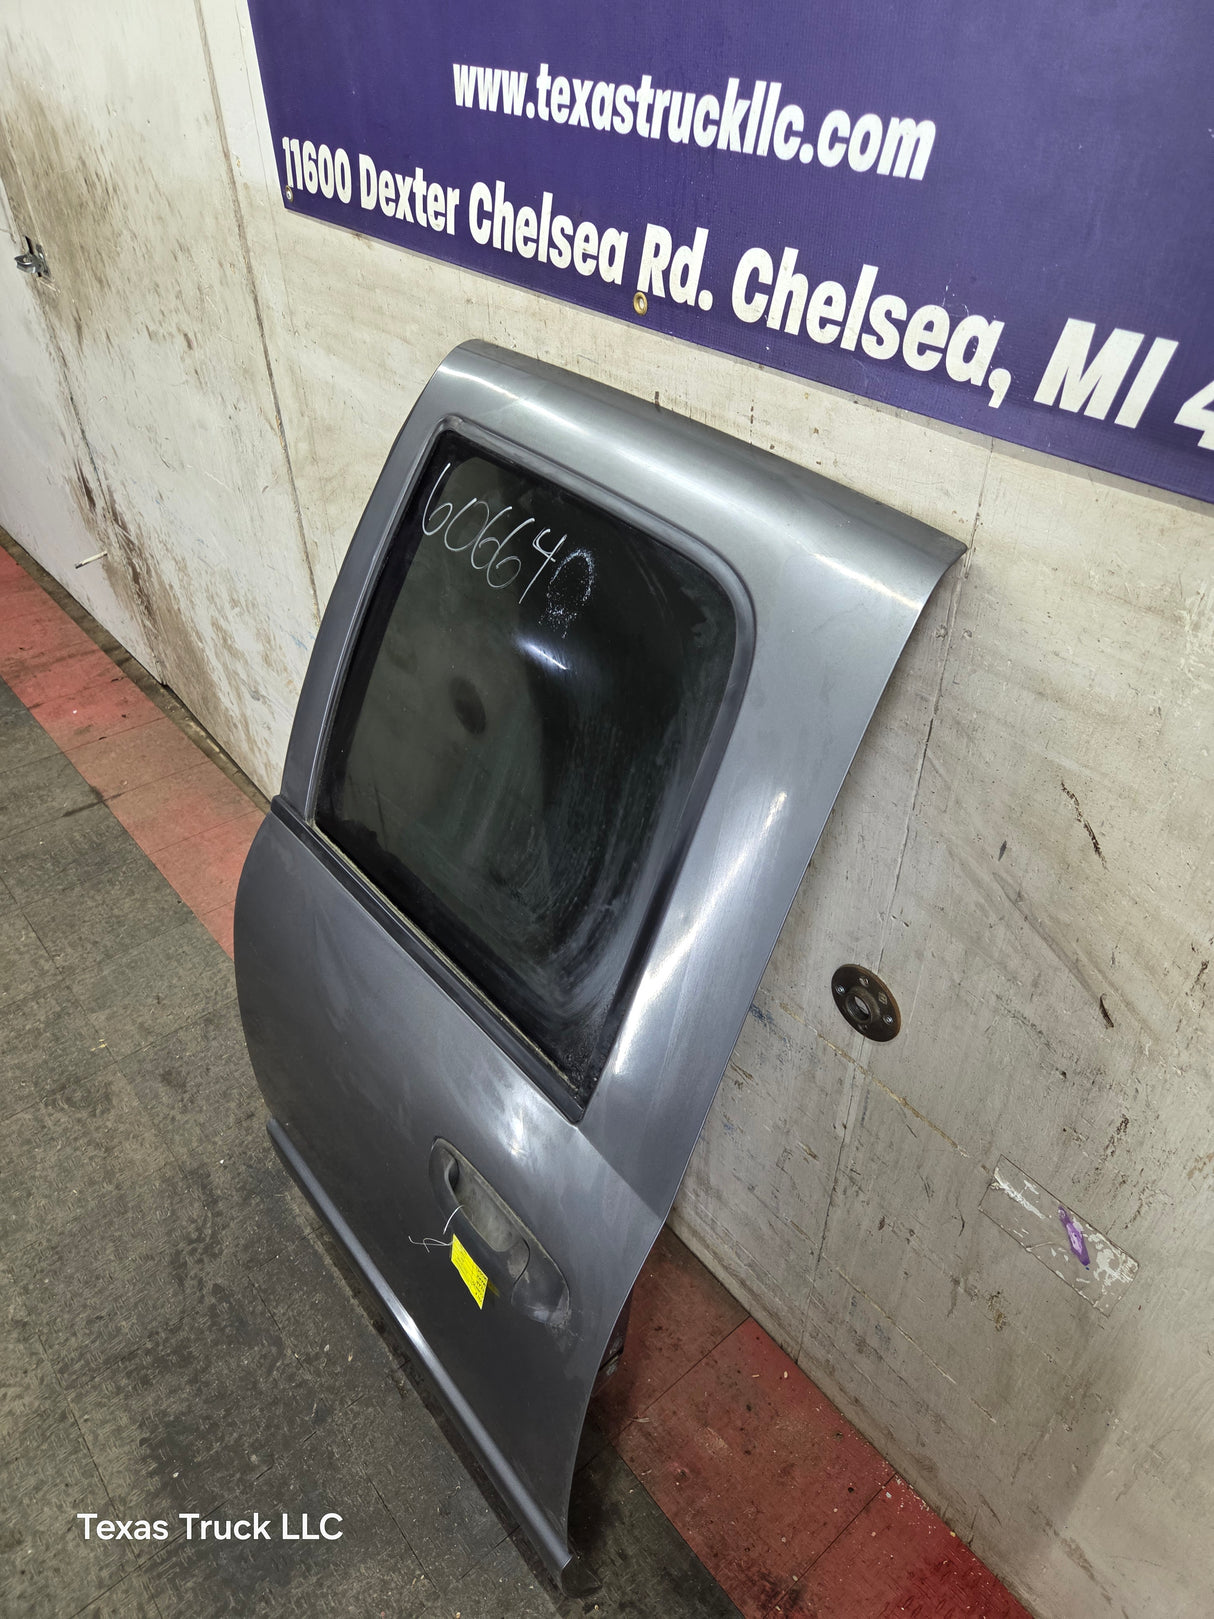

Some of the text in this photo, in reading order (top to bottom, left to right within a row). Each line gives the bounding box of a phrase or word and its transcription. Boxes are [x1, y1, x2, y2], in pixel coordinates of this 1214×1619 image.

[453, 63, 936, 180] www.texastruckllc.com
[282, 136, 352, 204] 11600
[358, 153, 460, 235] Dexter
[468, 180, 629, 285] Chelsea
[636, 223, 714, 311] Rd.
[731, 246, 1012, 408] Chelsea,
[1033, 317, 1179, 429] MI
